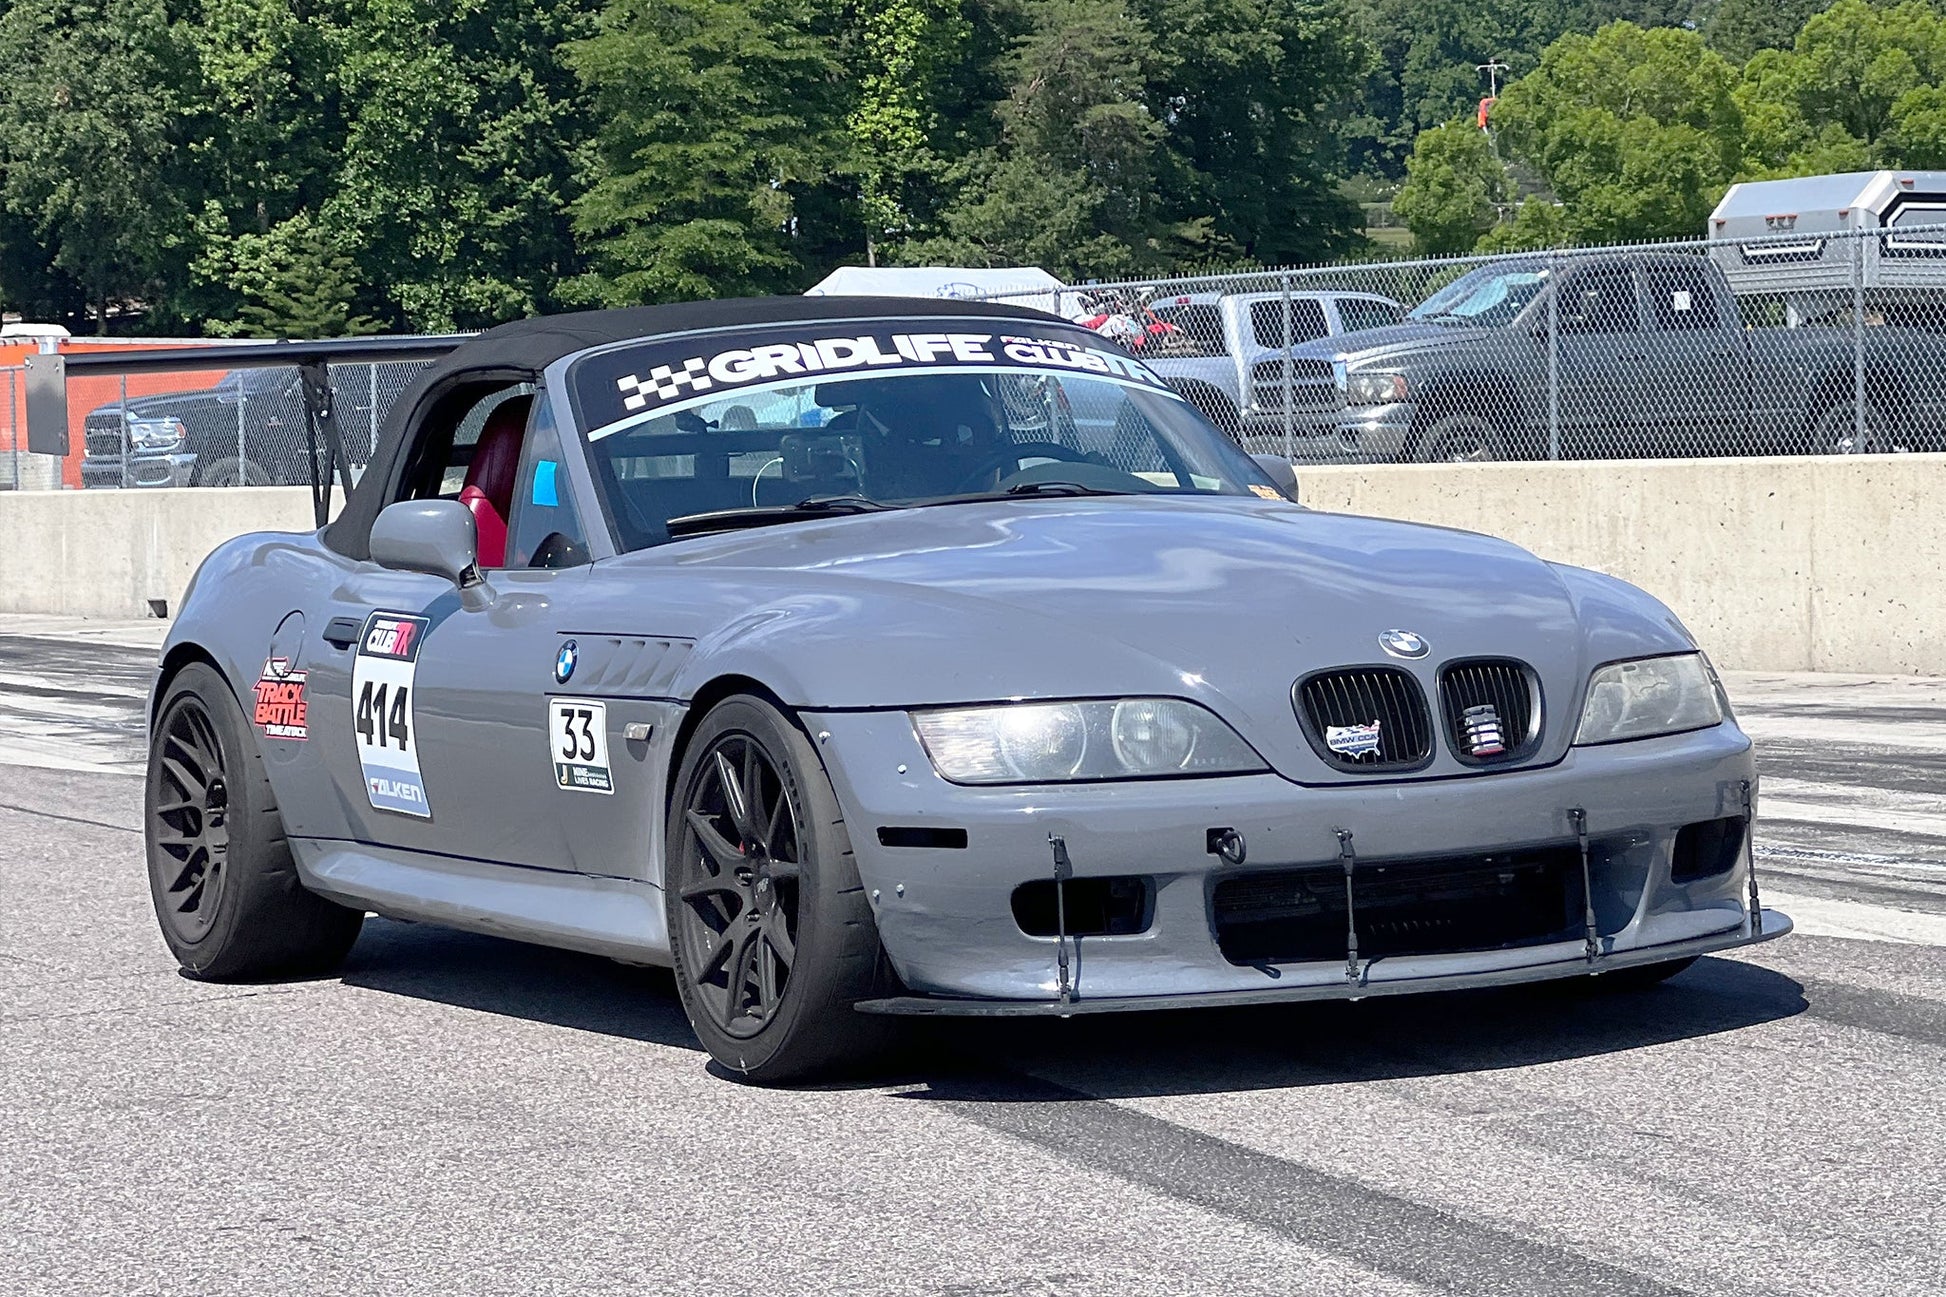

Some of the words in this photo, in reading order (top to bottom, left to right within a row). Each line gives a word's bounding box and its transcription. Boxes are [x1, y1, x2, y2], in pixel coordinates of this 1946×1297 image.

[1000, 336, 1081, 351] FALKEN
[708, 334, 995, 383] GRIDLIFE
[257, 681, 303, 704] TRACK
[255, 703, 306, 726] BATTLE
[357, 681, 408, 752] 414
[560, 708, 596, 761] 33
[1329, 737, 1355, 745] BMW
[1358, 733, 1378, 742] CCA
[370, 777, 423, 803] FALKEN
